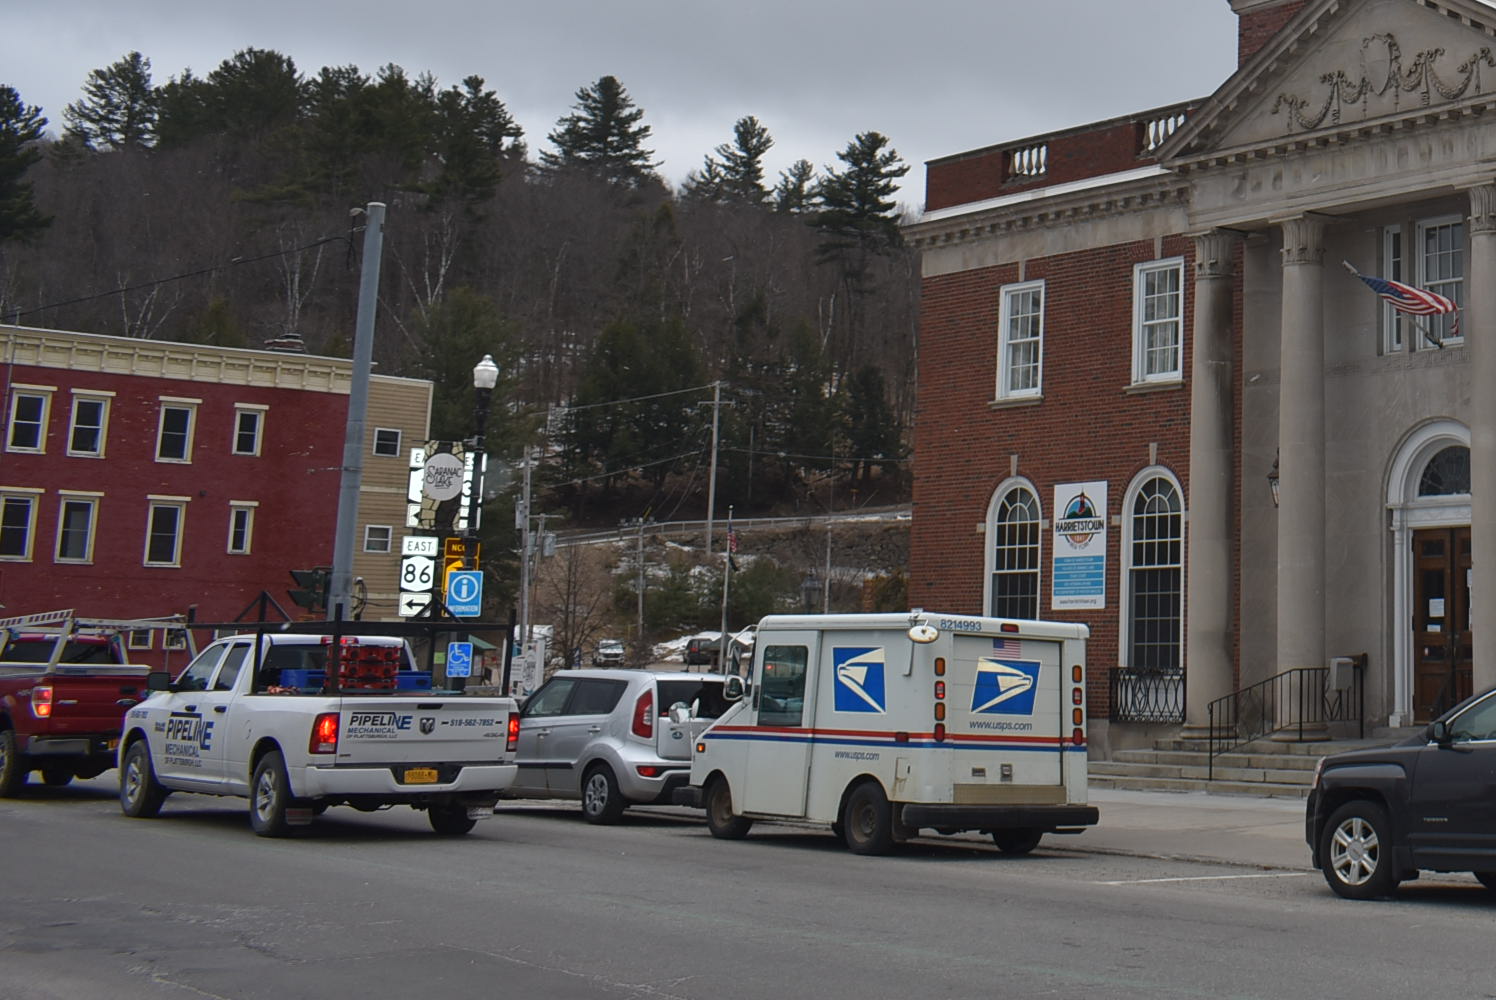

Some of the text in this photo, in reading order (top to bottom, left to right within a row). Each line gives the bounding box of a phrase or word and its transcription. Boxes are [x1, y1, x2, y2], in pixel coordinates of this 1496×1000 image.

[426, 465, 462, 484] SARANAC
[1055, 520, 1104, 532] HARRIETSTOWN
[407, 541, 433, 552] EAST
[403, 563, 431, 584] 86
[940, 619, 982, 631] 8214993
[350, 714, 413, 730] PIPELINE
[969, 720, 1032, 731] www.usps.com
[166, 718, 214, 750] PIPELINE
[165, 743, 199, 757] MECHANICAL
[834, 751, 880, 761] www.usps.com
